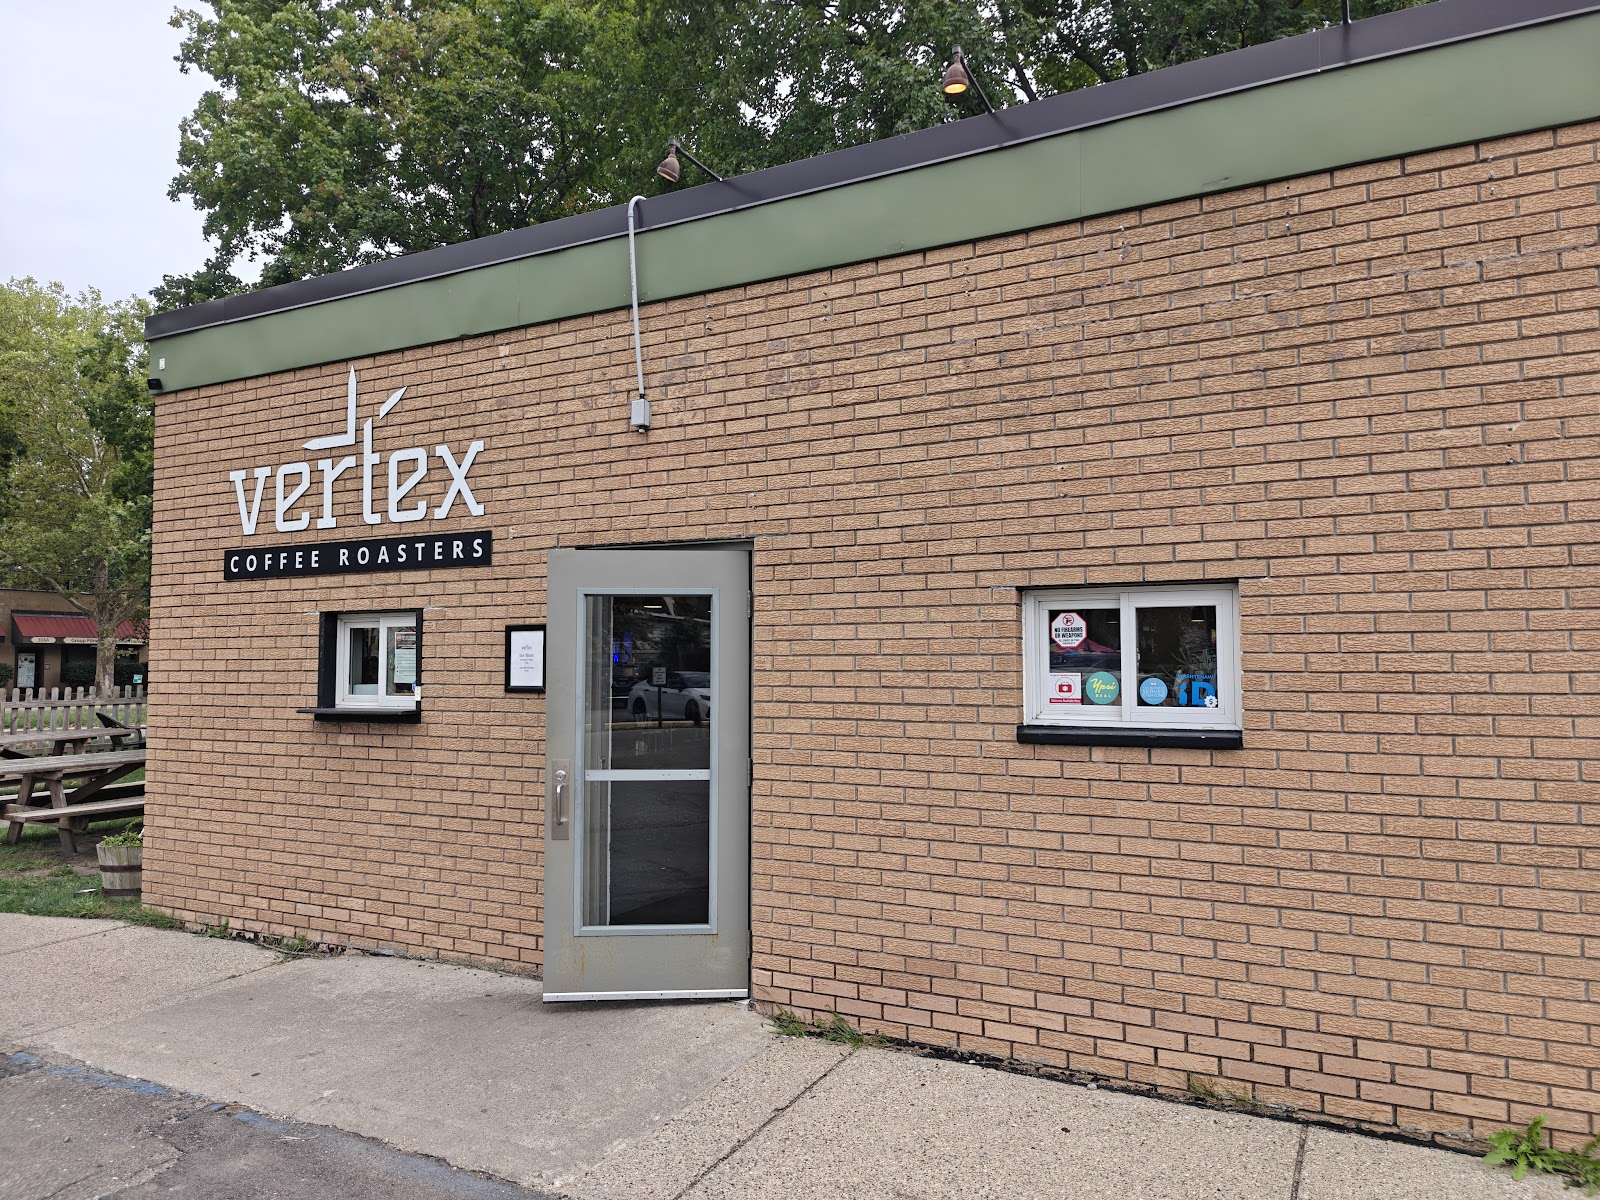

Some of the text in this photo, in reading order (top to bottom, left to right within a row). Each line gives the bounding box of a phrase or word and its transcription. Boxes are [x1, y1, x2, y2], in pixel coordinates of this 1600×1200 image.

[230, 417, 484, 535] vertex
[230, 538, 483, 572] COFFEE ROASTERS
[1090, 678, 1117, 693] Ypsi
